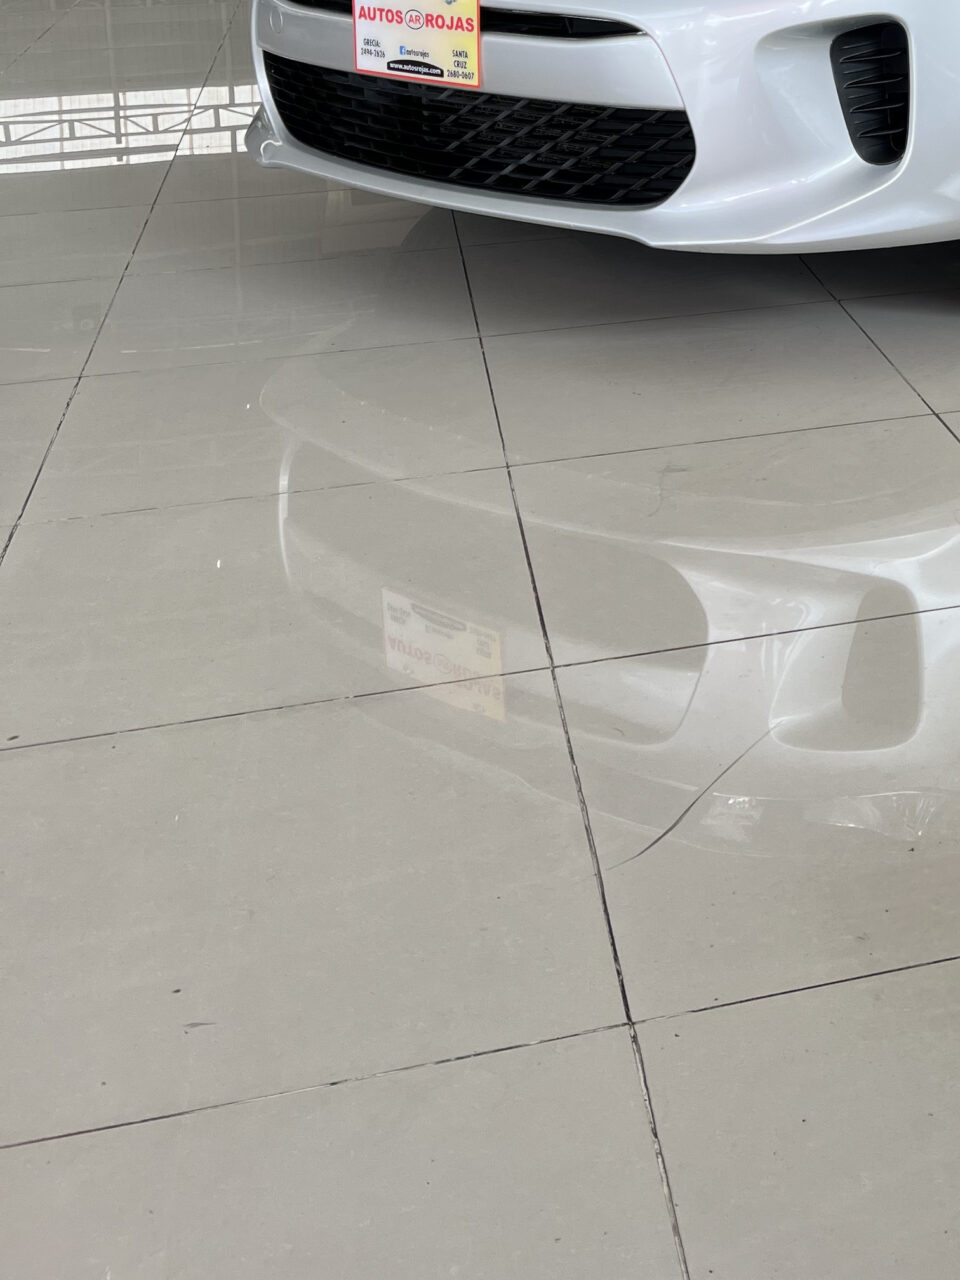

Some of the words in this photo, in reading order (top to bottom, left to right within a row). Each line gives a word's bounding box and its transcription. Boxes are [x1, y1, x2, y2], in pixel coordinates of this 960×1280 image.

[358, 6, 403, 25] AUTOS
[408, 13, 421, 26] AR
[425, 13, 475, 32] ROJAS
[452, 49, 468, 59] SANTA
[389, 63, 442, 75] www.autosrojas.com
[453, 60, 467, 69] CRUZ
